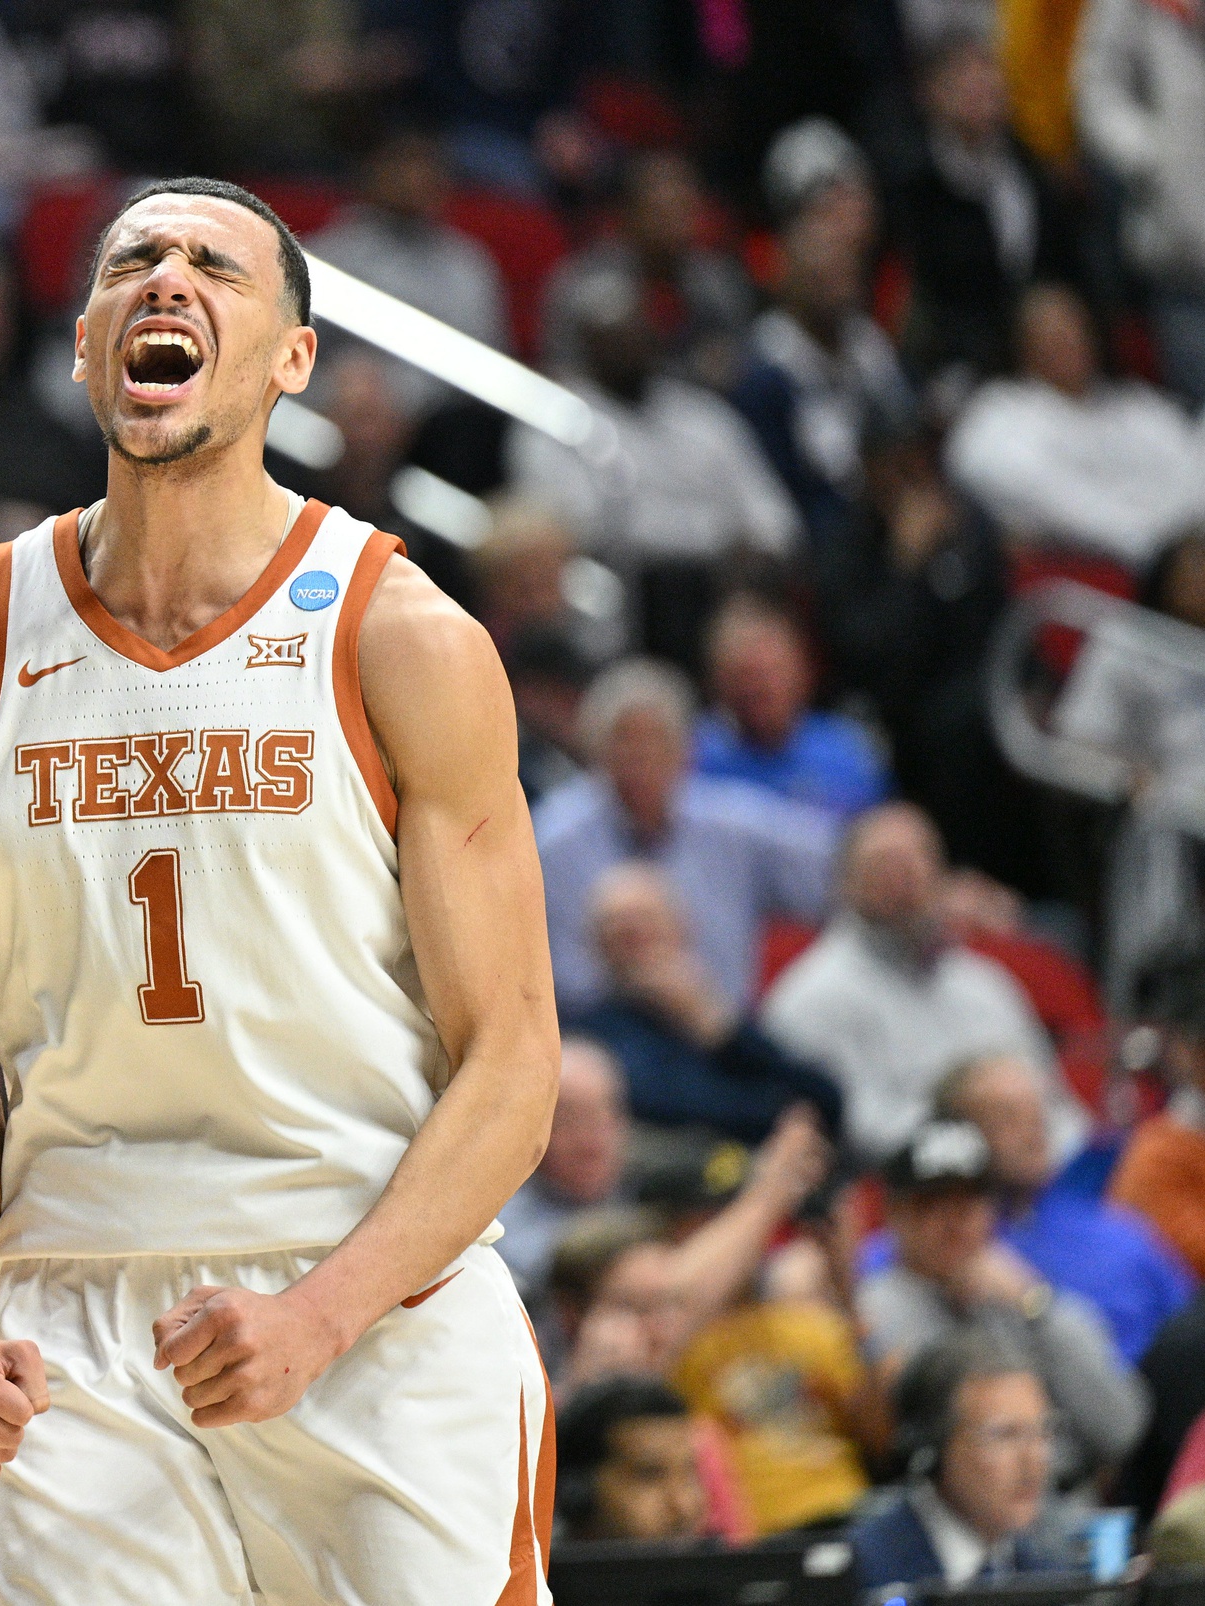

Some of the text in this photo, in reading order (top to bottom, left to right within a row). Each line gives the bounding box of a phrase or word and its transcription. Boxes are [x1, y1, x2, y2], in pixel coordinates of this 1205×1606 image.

[296, 588, 335, 600] NCAA
[247, 633, 307, 668] XII
[15, 729, 313, 827] TEXAS
[128, 848, 204, 1025] 1
